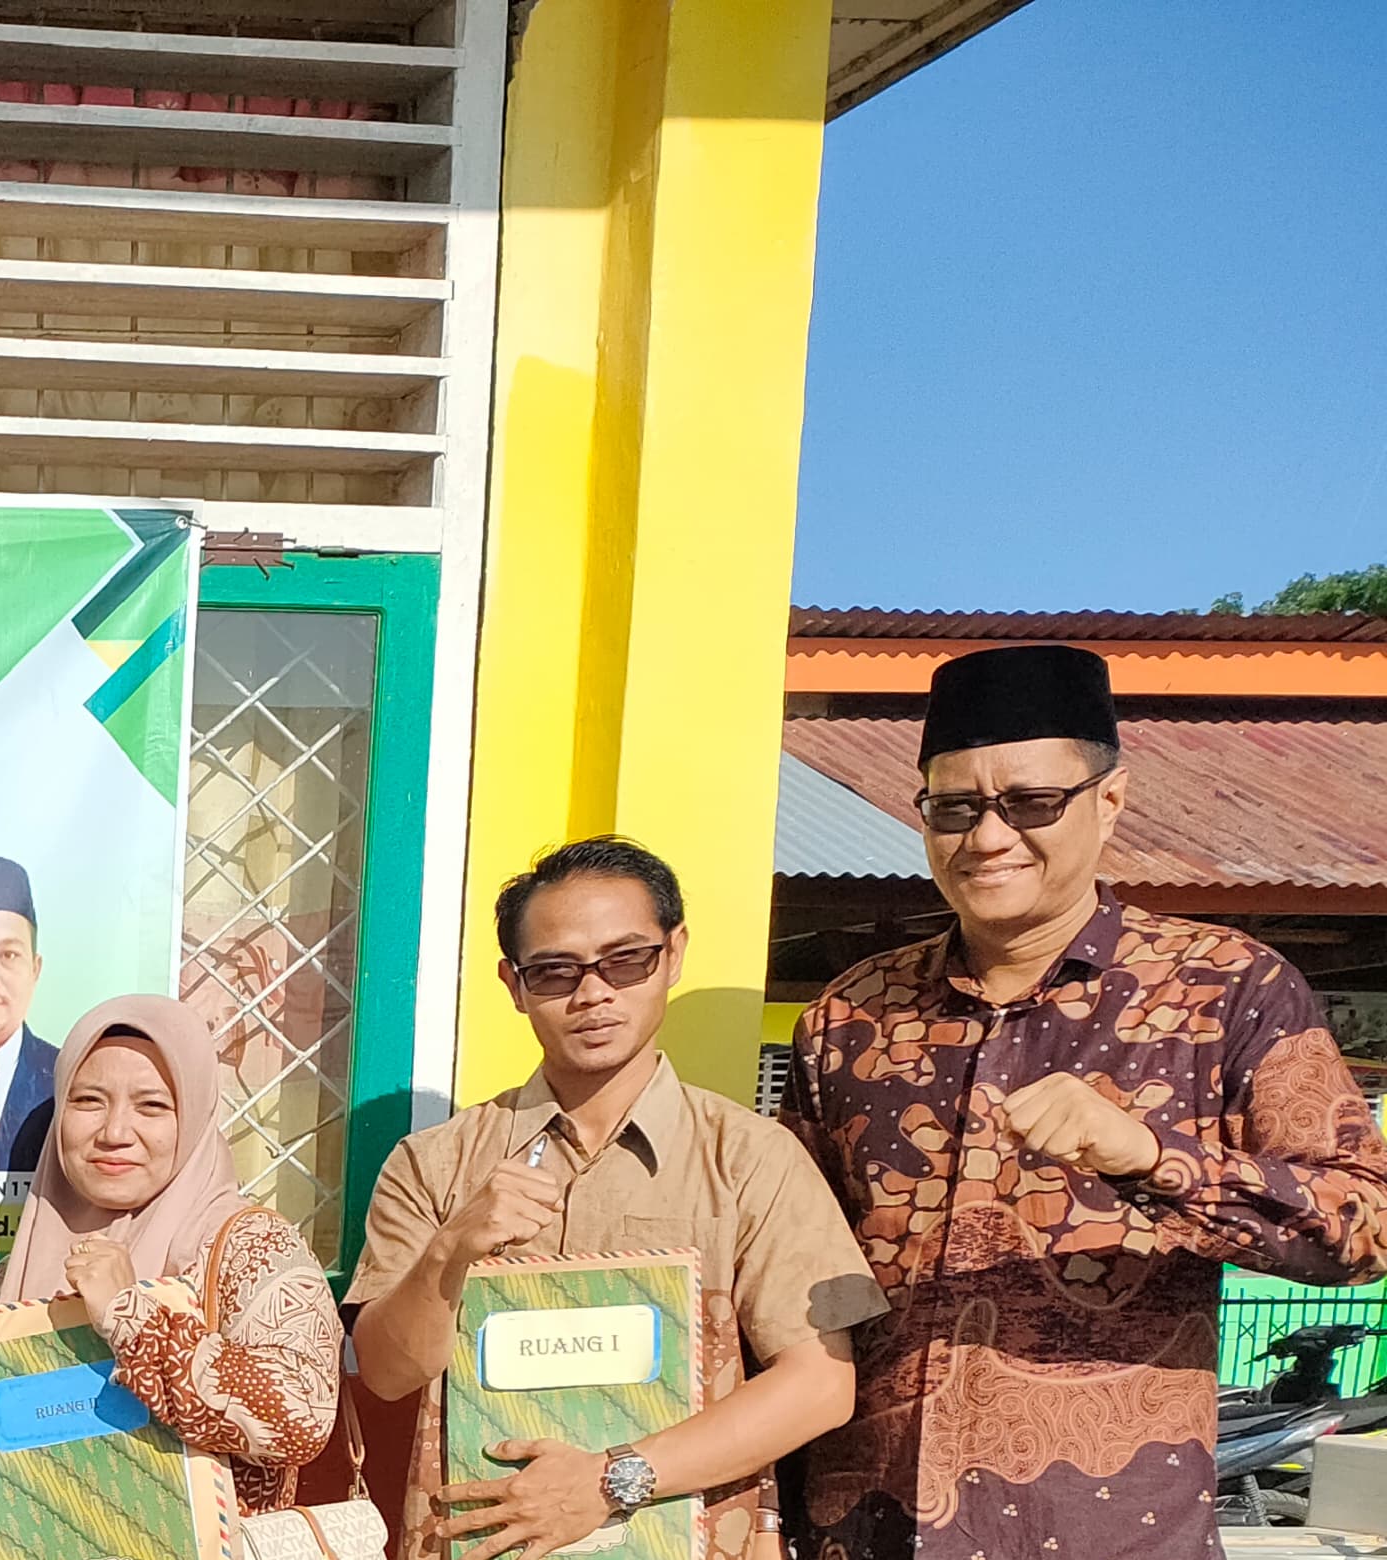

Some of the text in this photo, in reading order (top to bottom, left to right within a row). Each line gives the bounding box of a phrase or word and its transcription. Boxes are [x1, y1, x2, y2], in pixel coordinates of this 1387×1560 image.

[520, 1336, 604, 1357] RUANG
[35, 1397, 99, 1419] RUANG II
